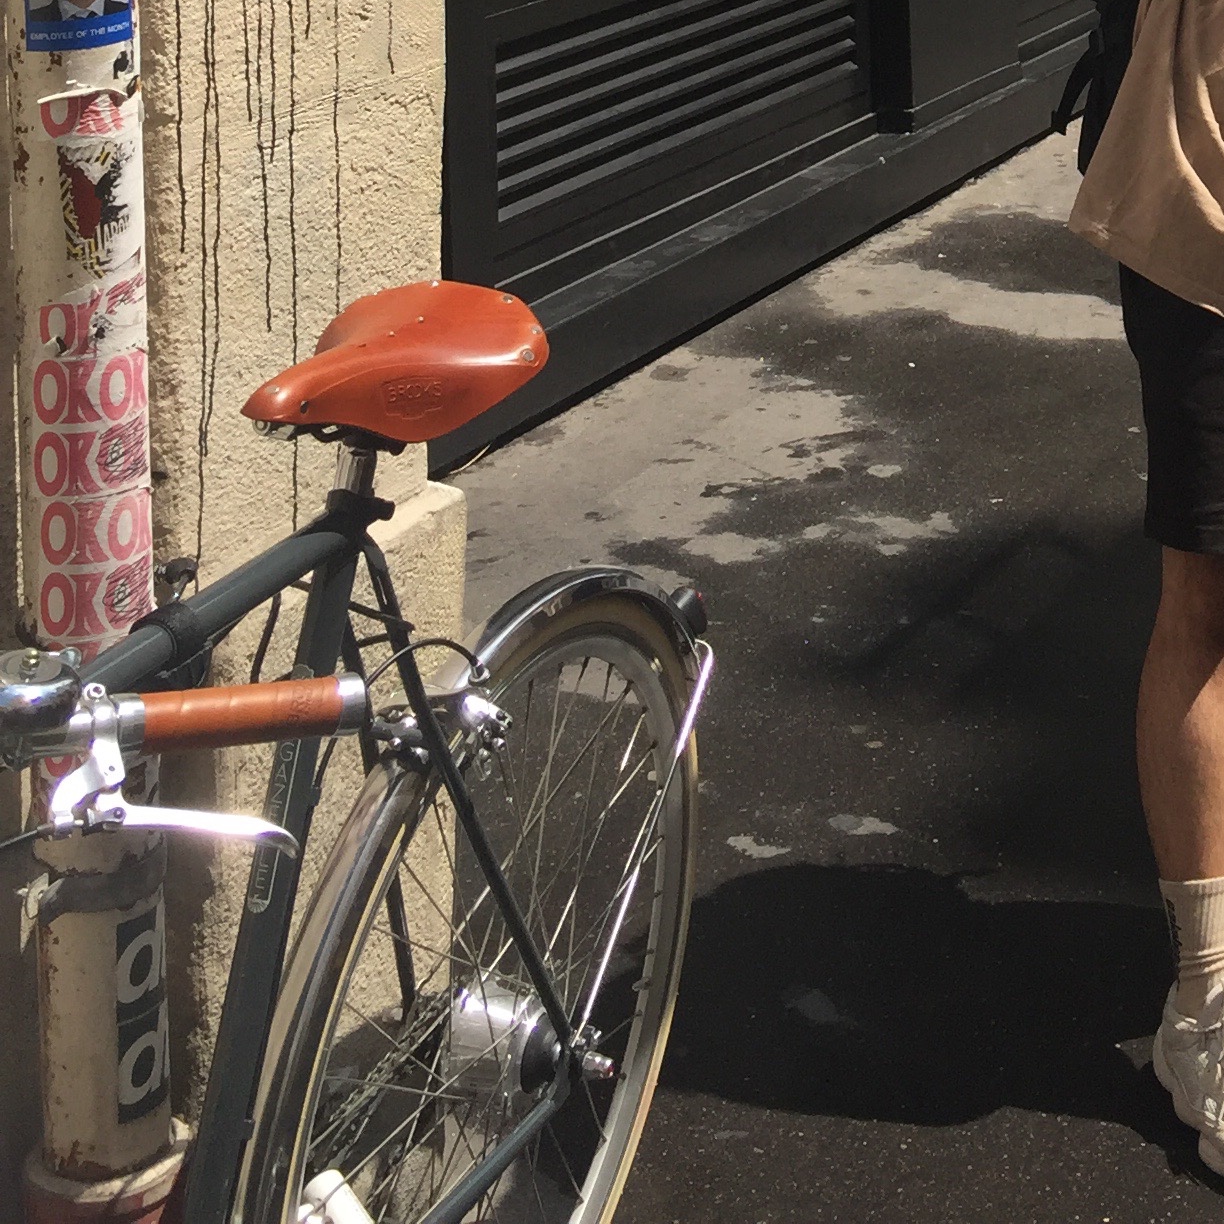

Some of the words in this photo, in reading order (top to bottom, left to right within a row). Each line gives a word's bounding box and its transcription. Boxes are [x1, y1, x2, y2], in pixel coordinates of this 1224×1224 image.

[30, 31, 74, 41] EMPLOYEE
[76, 29, 87, 39] OF
[90, 27, 106, 36] THE
[108, 21, 130, 33] MONTH
[254, 742, 296, 891] GAZELE
